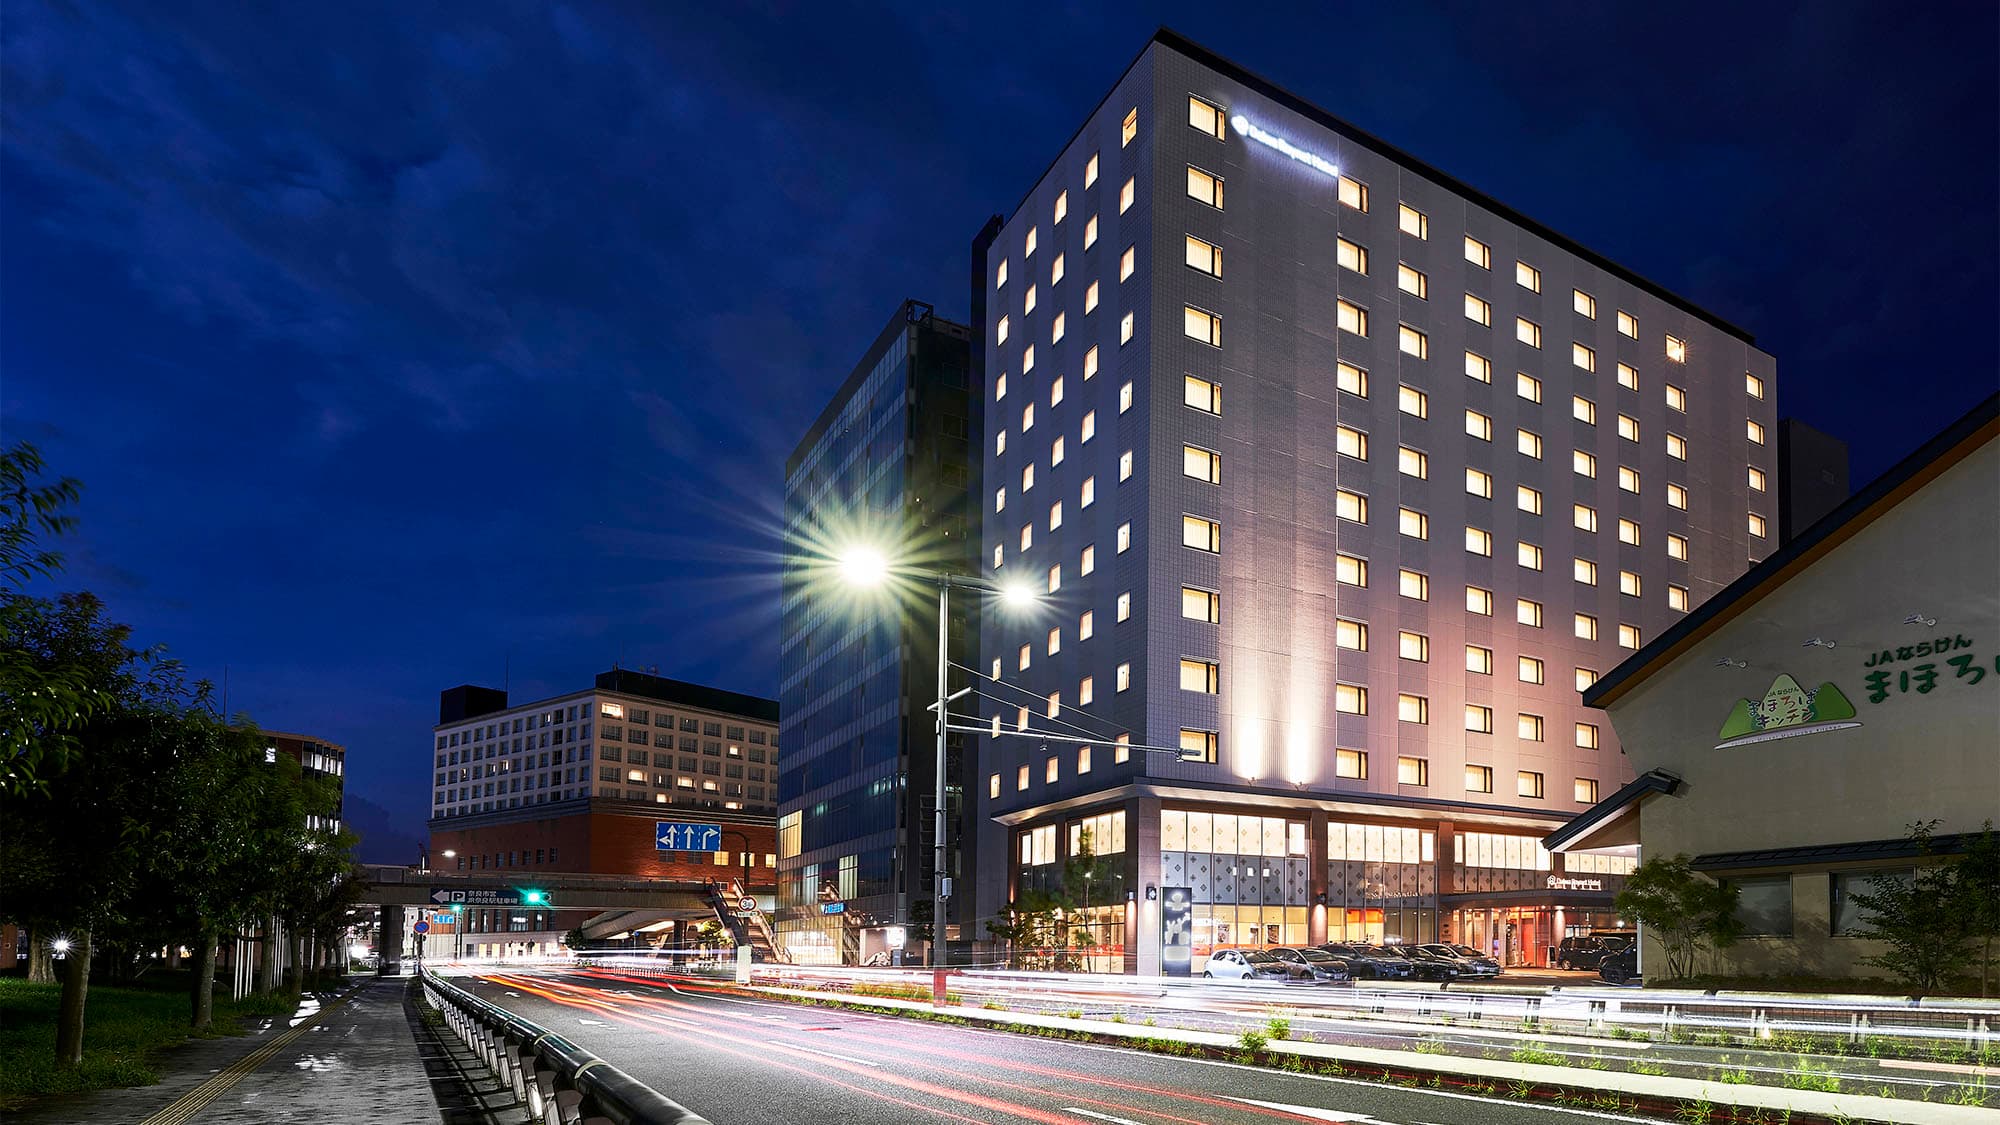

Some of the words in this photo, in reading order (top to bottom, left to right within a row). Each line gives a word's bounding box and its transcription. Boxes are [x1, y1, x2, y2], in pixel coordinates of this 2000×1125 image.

[1864, 634, 1972, 667] JAならけん
[1864, 654, 2000, 703] まほろ
[1748, 688, 1818, 716] まほろば
[1757, 708, 1814, 728] キッチン
